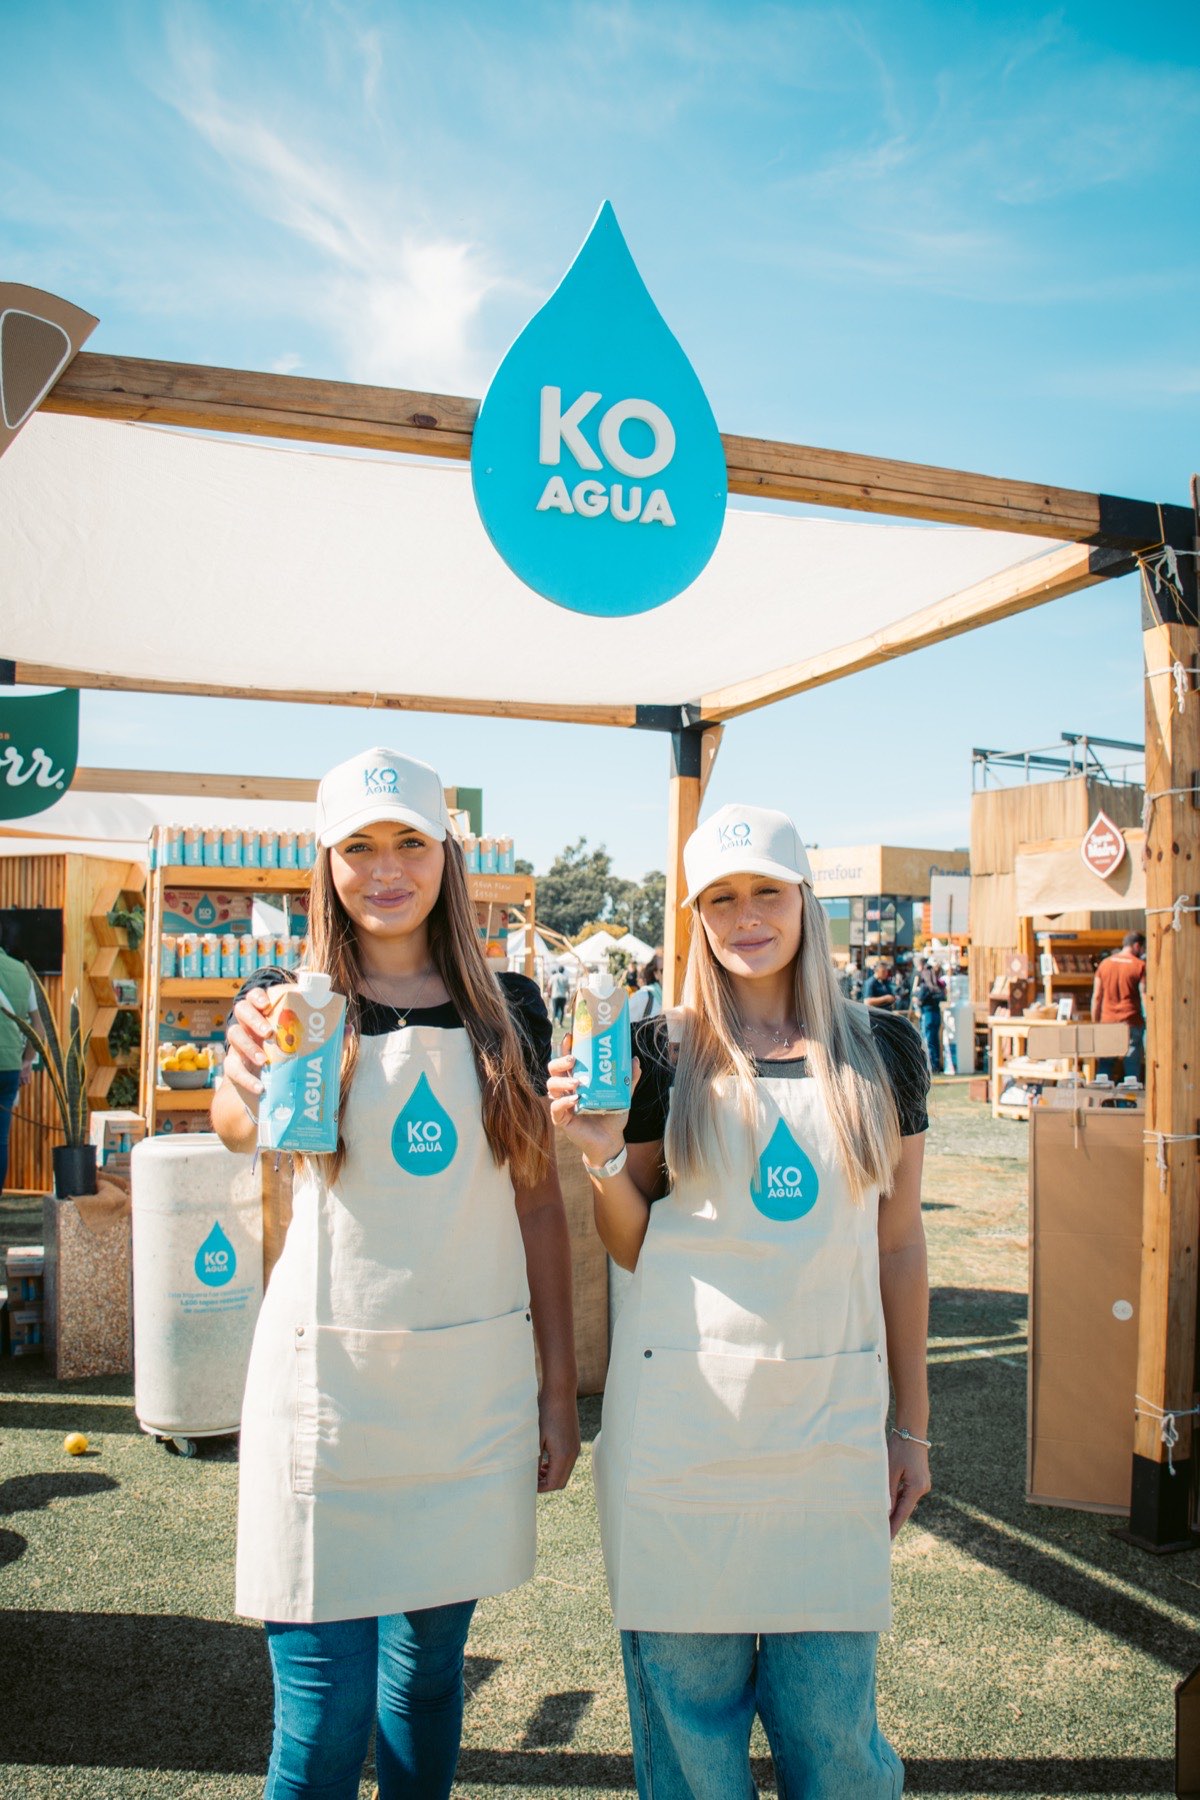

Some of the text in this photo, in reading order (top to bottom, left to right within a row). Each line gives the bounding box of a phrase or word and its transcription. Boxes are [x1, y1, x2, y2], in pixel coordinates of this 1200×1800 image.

[539, 385, 676, 479] KO
[536, 475, 676, 527] AGUA
[364, 767, 398, 786] KO
[719, 822, 751, 843] KO
[812, 864, 863, 881] arrefour
[598, 1001, 612, 1025] KO
[308, 1012, 326, 1043] KO
[598, 1035, 612, 1086] AGUA
[304, 1056, 323, 1122] AGUA
[407, 1121, 442, 1143] KO
[408, 1141, 443, 1153] AGUA
[767, 1166, 802, 1188] KO
[767, 1187, 803, 1199] AGUA
[204, 1250, 229, 1266] KO
[205, 1265, 229, 1273] AGUA
